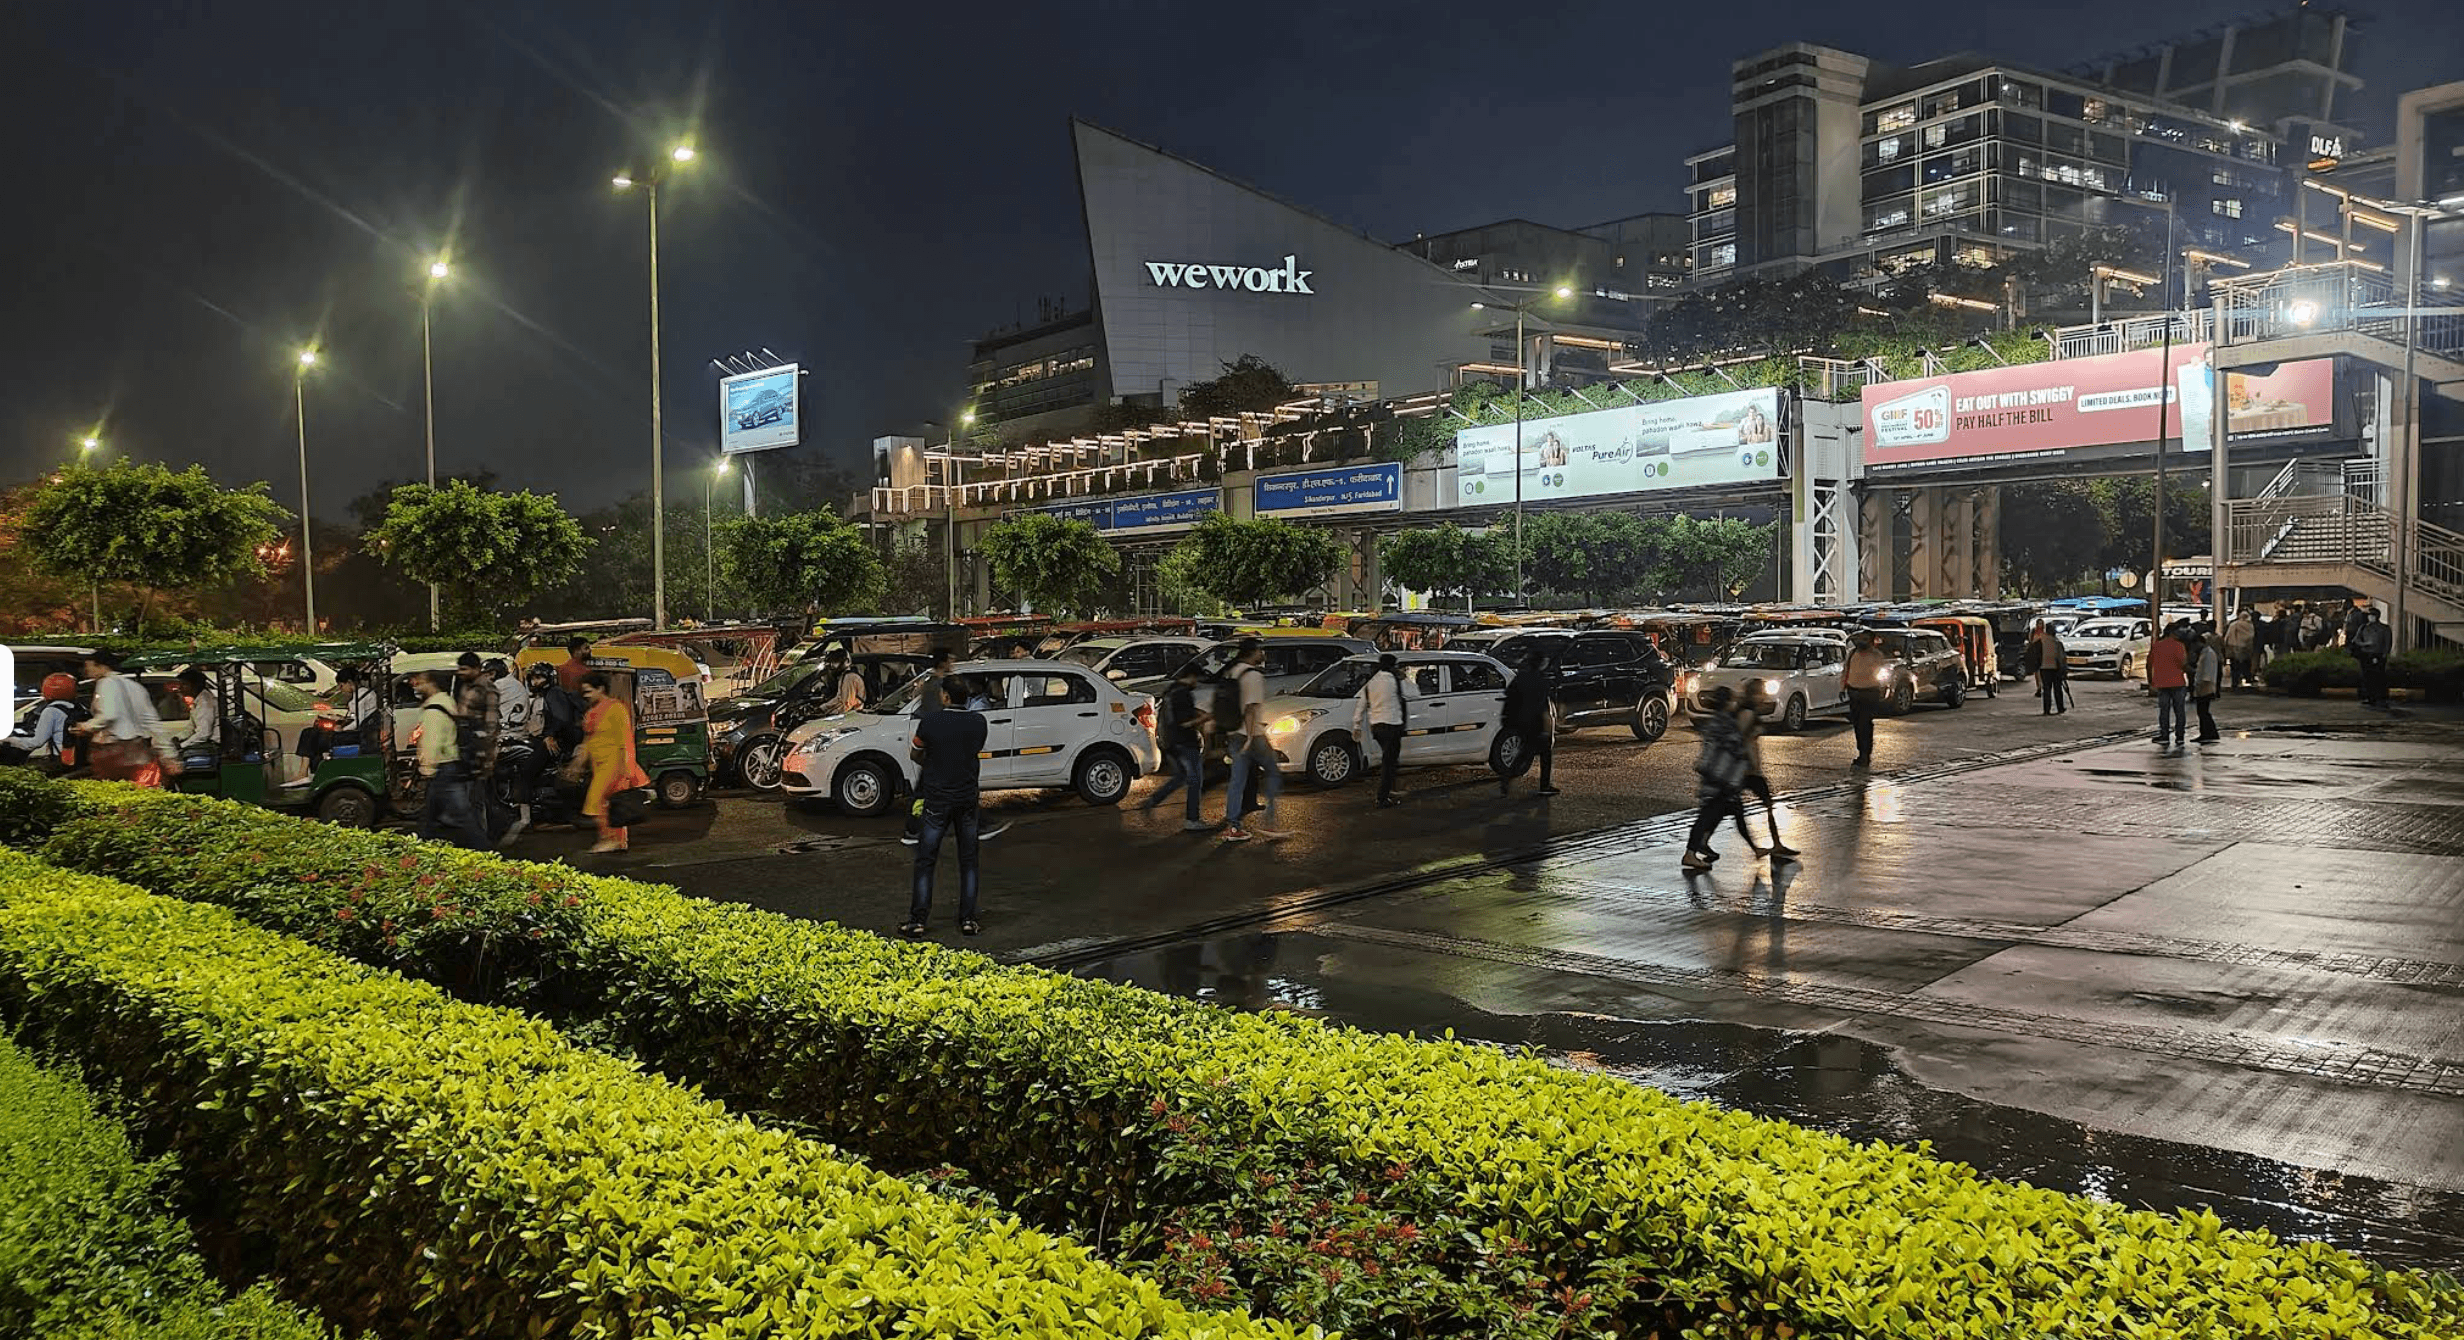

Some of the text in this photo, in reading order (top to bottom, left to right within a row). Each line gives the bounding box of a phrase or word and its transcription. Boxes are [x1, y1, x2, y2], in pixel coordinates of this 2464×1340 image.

[2311, 135, 2332, 156] DLF
[1145, 254, 1315, 294] wework
[1956, 386, 2074, 412] EAT OUT WITH SWIGGY
[2081, 397, 2108, 407] LIMITED
[2133, 392, 2153, 402] BOOK
[1956, 408, 2053, 430] PAY HALF THE BILL
[1354, 489, 1383, 499] Faridabad
